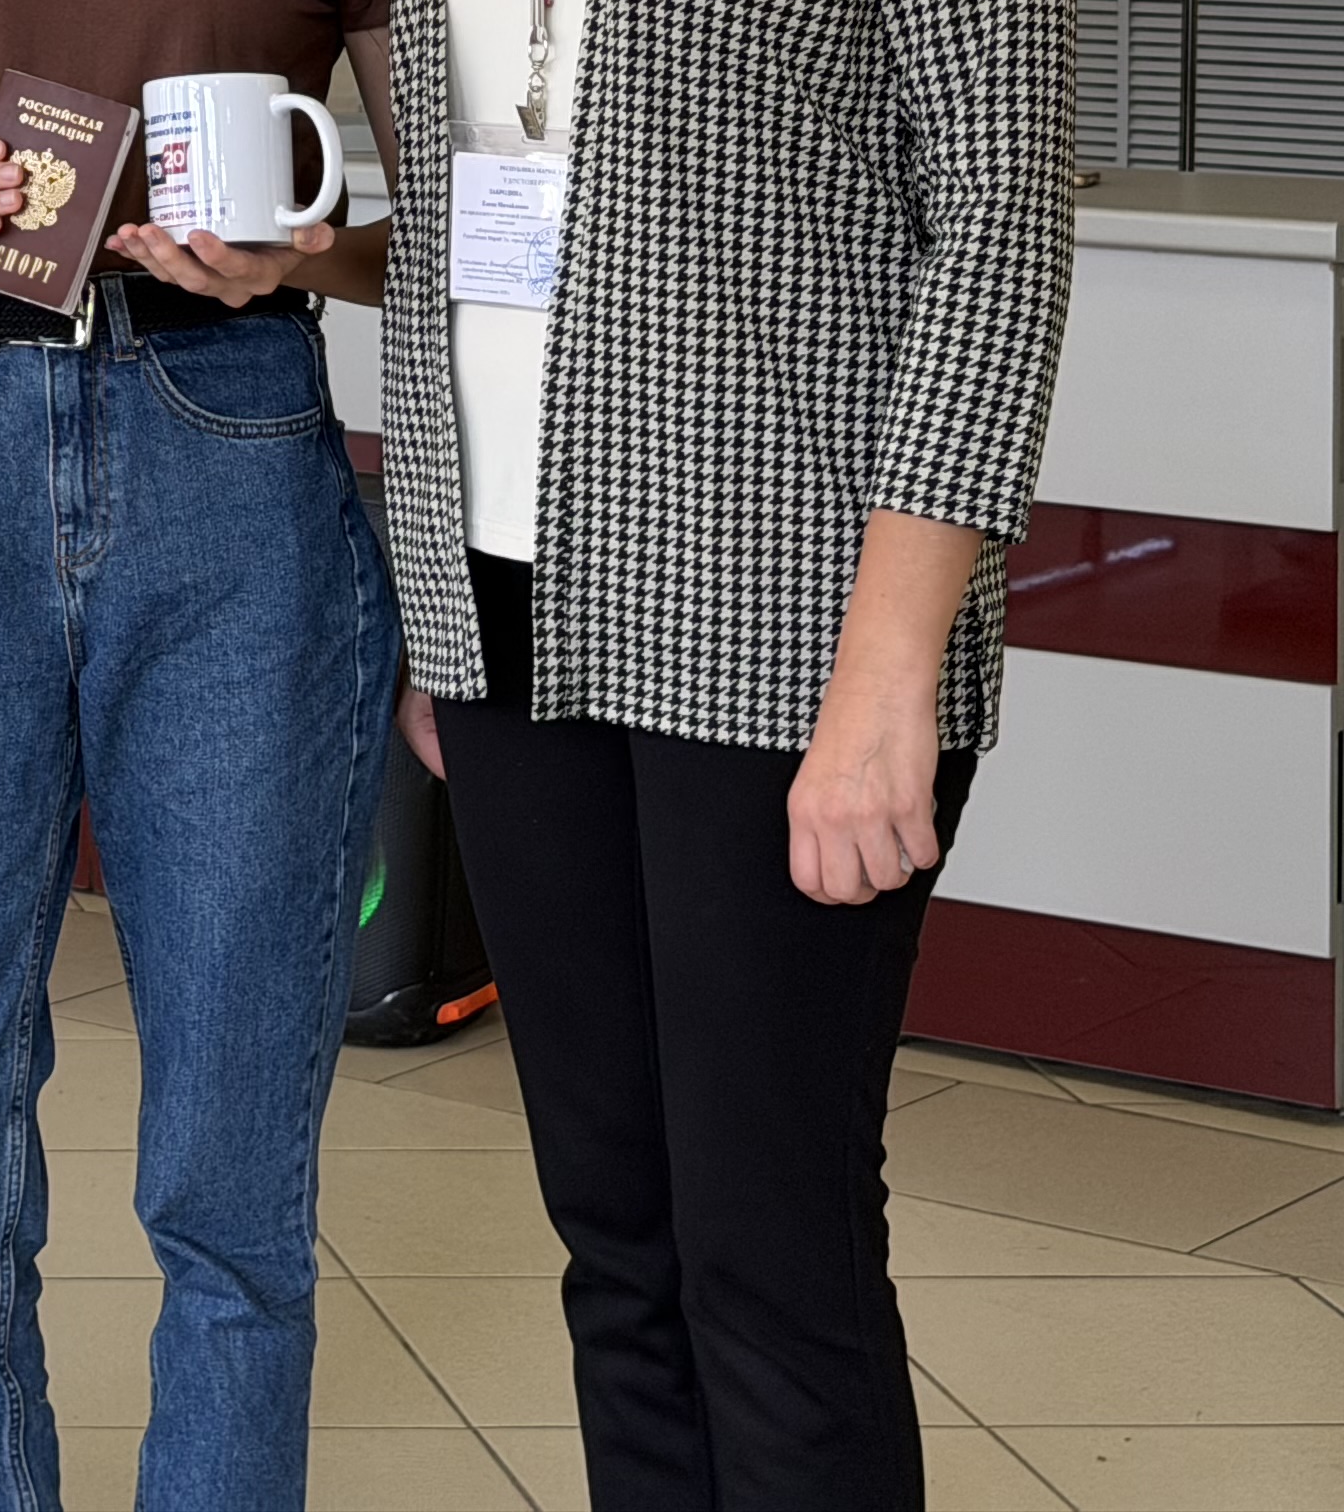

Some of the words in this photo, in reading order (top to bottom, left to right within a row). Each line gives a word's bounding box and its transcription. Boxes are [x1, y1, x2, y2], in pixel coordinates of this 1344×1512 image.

[17, 96, 104, 132] РОССИЙСКАЯ
[18, 112, 95, 145] ФЕДЕРАЦИЯ
[163, 149, 186, 169] 20
